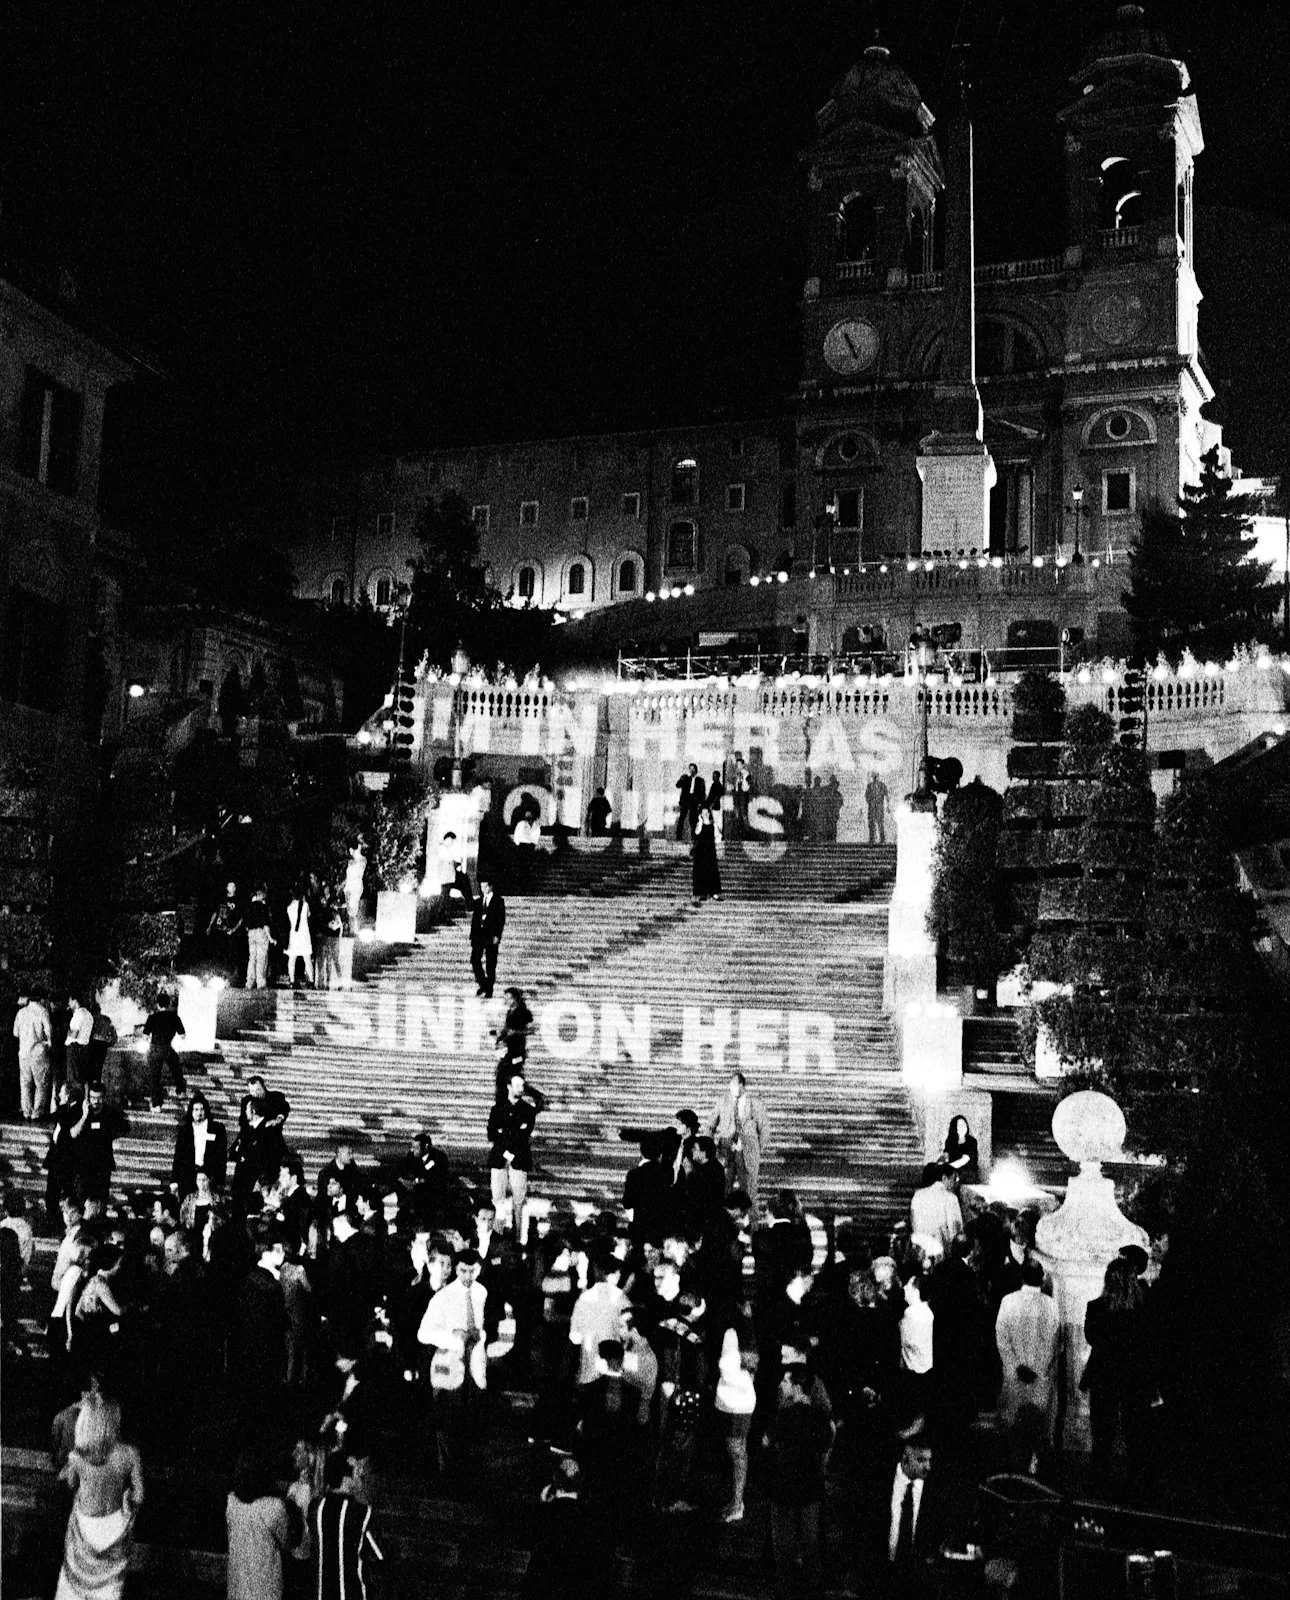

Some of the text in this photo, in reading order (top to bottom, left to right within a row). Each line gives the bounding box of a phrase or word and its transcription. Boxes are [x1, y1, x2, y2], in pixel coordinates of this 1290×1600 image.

[628, 704, 779, 766] HER
[805, 716, 903, 772] AS
[538, 1000, 652, 1064] ON
[681, 1007, 837, 1071] HER
